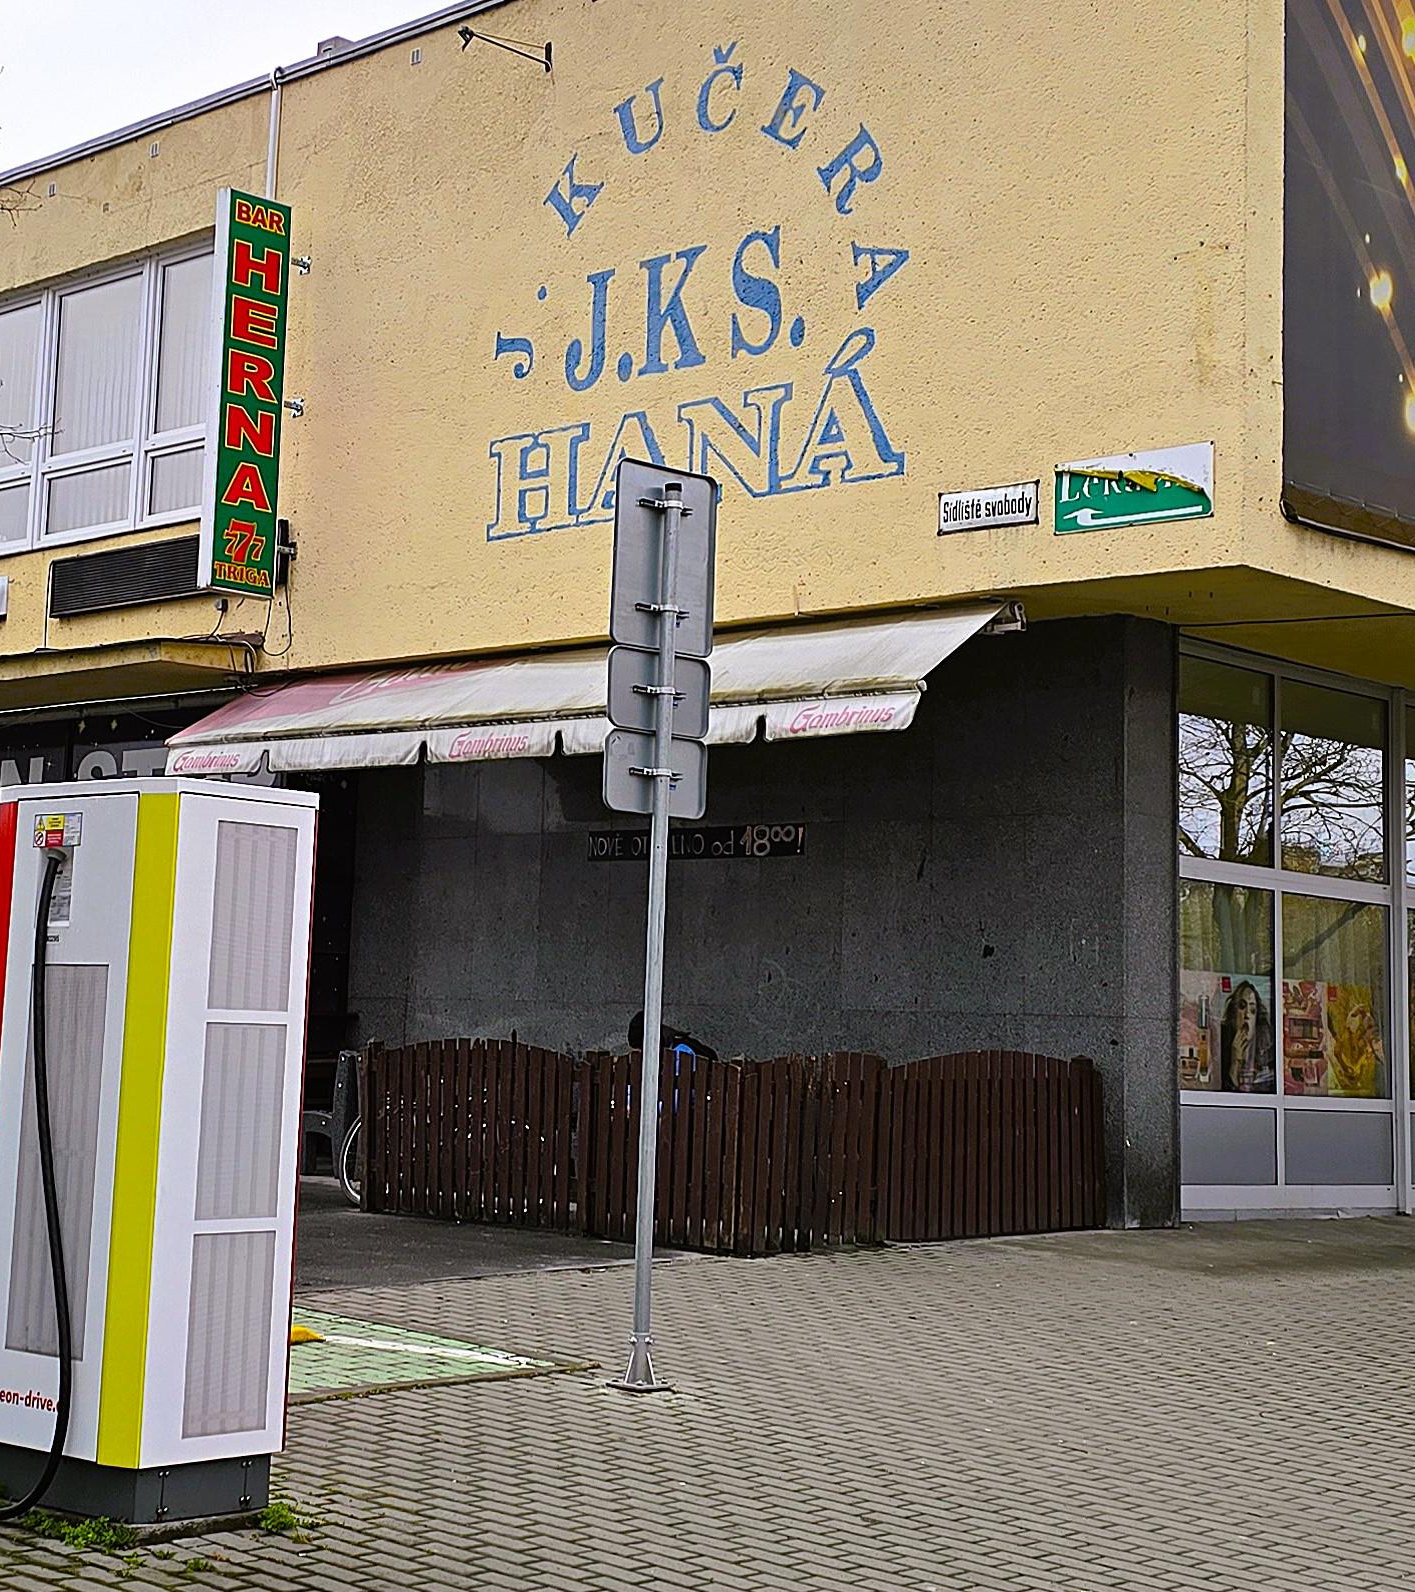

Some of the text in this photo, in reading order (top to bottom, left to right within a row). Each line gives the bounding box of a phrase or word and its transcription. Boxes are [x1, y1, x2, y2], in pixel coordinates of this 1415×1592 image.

[542, 41, 910, 312] KUČERA
[235, 199, 286, 236] BAR
[221, 239, 283, 514] HERNA
[486, 326, 905, 543] HANÁ
[985, 494, 1033, 519] svobody
[214, 562, 271, 589] TRIGA
[789, 704, 897, 734] Gambrinus
[447, 731, 530, 760] Gambrinus
[172, 749, 240, 773] Gambrinus
[711, 830, 734, 856] od
[0, 1389, 60, 1413] eon-drive.
